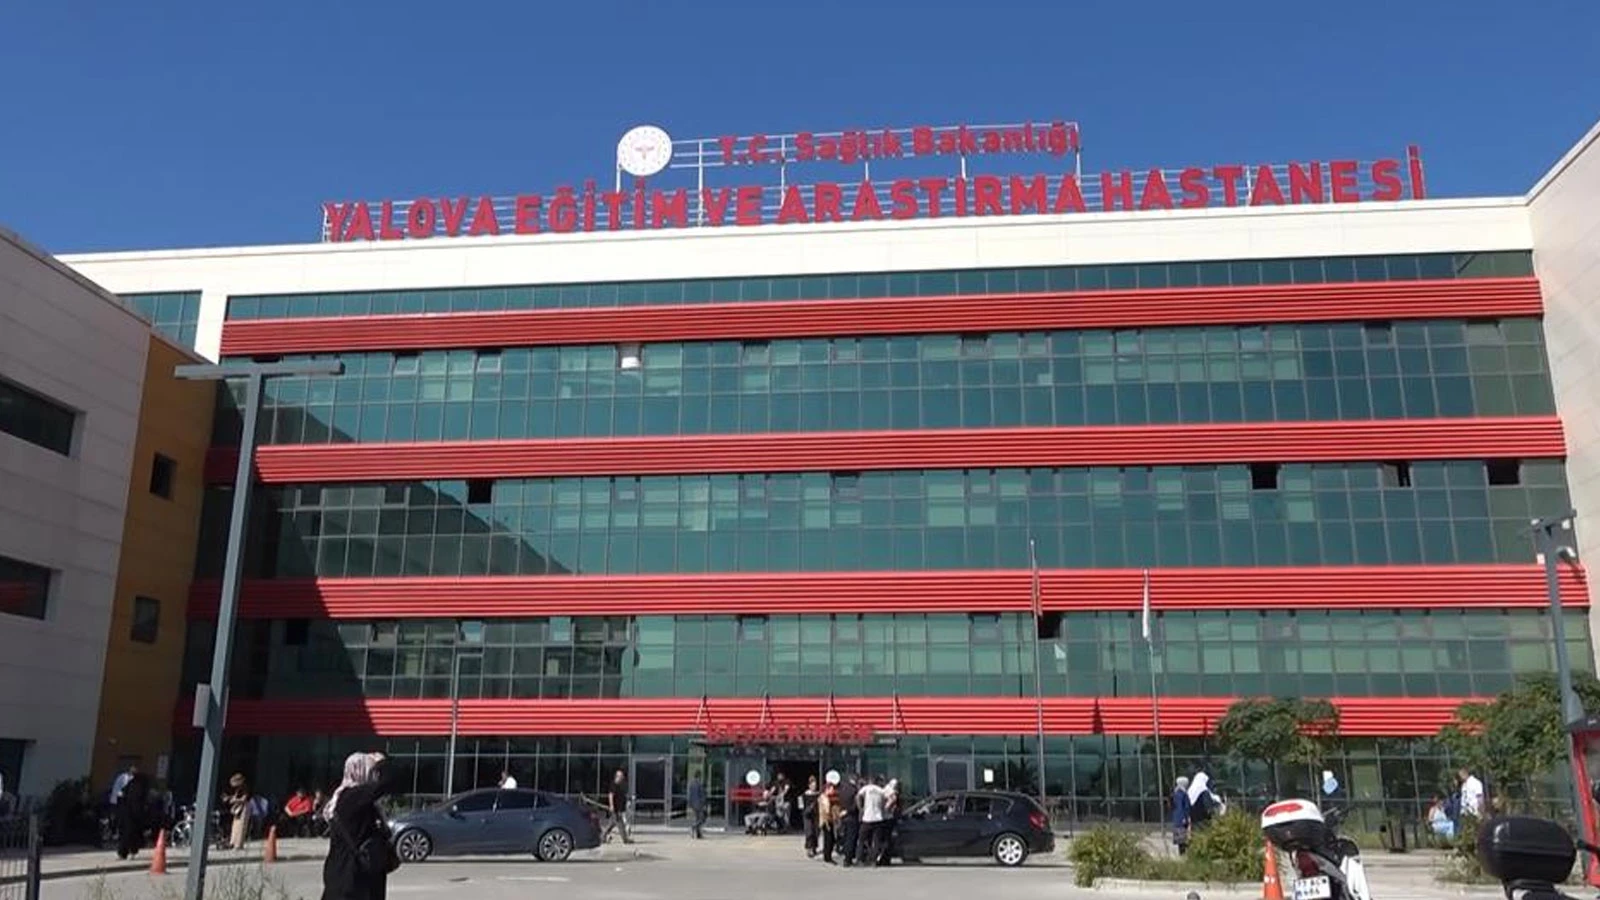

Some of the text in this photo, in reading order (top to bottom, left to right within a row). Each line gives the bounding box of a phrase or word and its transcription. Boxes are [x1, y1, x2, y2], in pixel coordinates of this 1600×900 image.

[795, 129, 902, 164] Sağlık
[912, 121, 1079, 157] Bakanlığı
[324, 197, 499, 243] YALOVA
[515, 176, 687, 236] EĞİTİM
[701, 185, 763, 227] VE
[1099, 144, 1425, 213] HASTANESİ
